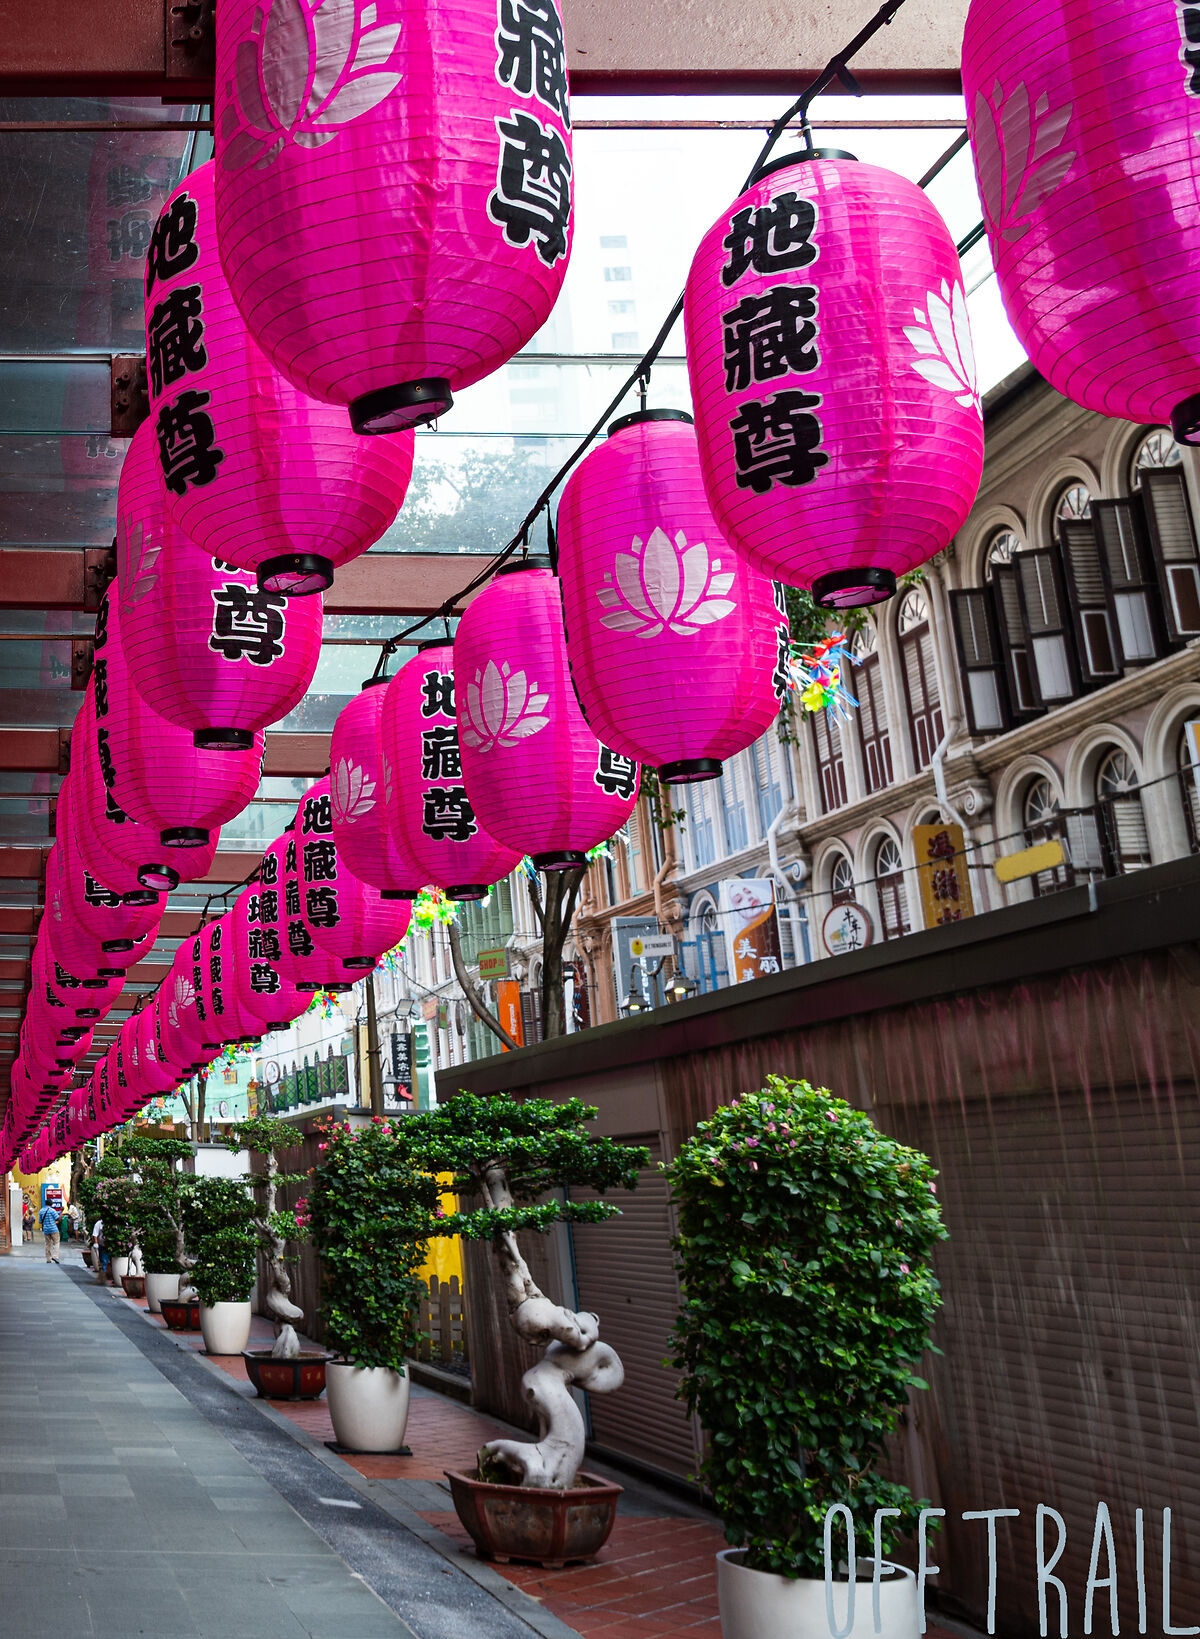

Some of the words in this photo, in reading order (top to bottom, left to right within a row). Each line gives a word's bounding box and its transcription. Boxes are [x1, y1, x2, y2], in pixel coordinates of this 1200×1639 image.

[146, 191, 225, 497] 地藏尊
[721, 191, 830, 495] 地藏尊
[420, 670, 478, 842] 地藏尊
[302, 794, 340, 928] 地藏尊
[480, 959, 497, 970] SHOP
